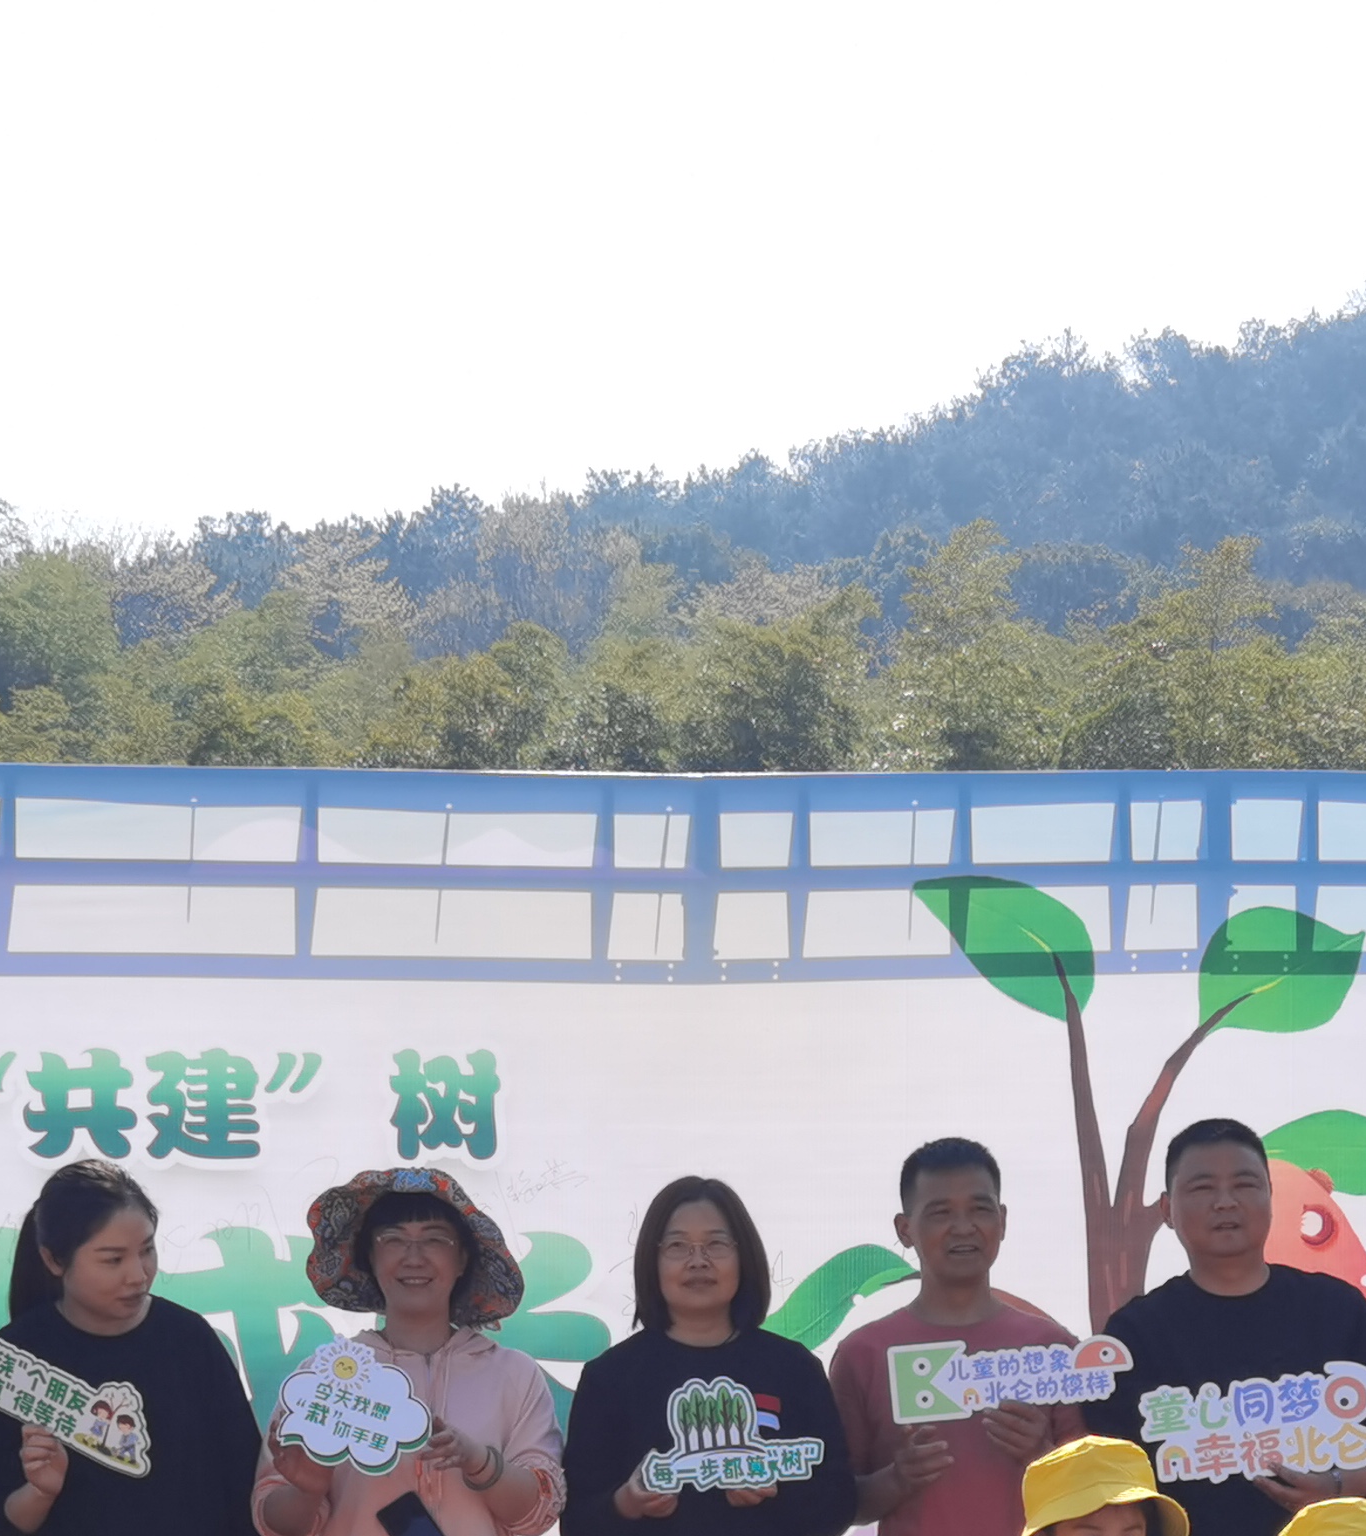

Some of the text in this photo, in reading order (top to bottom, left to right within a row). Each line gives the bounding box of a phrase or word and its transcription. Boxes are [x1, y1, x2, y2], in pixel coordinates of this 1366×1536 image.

[389, 1048, 502, 1161] 树
[948, 1349, 1073, 1382] 儿童的想象
[314, 1382, 391, 1422] 今天我想
[985, 1371, 1111, 1404] 北仑的模样
[1145, 1377, 1321, 1436] 童心同梦
